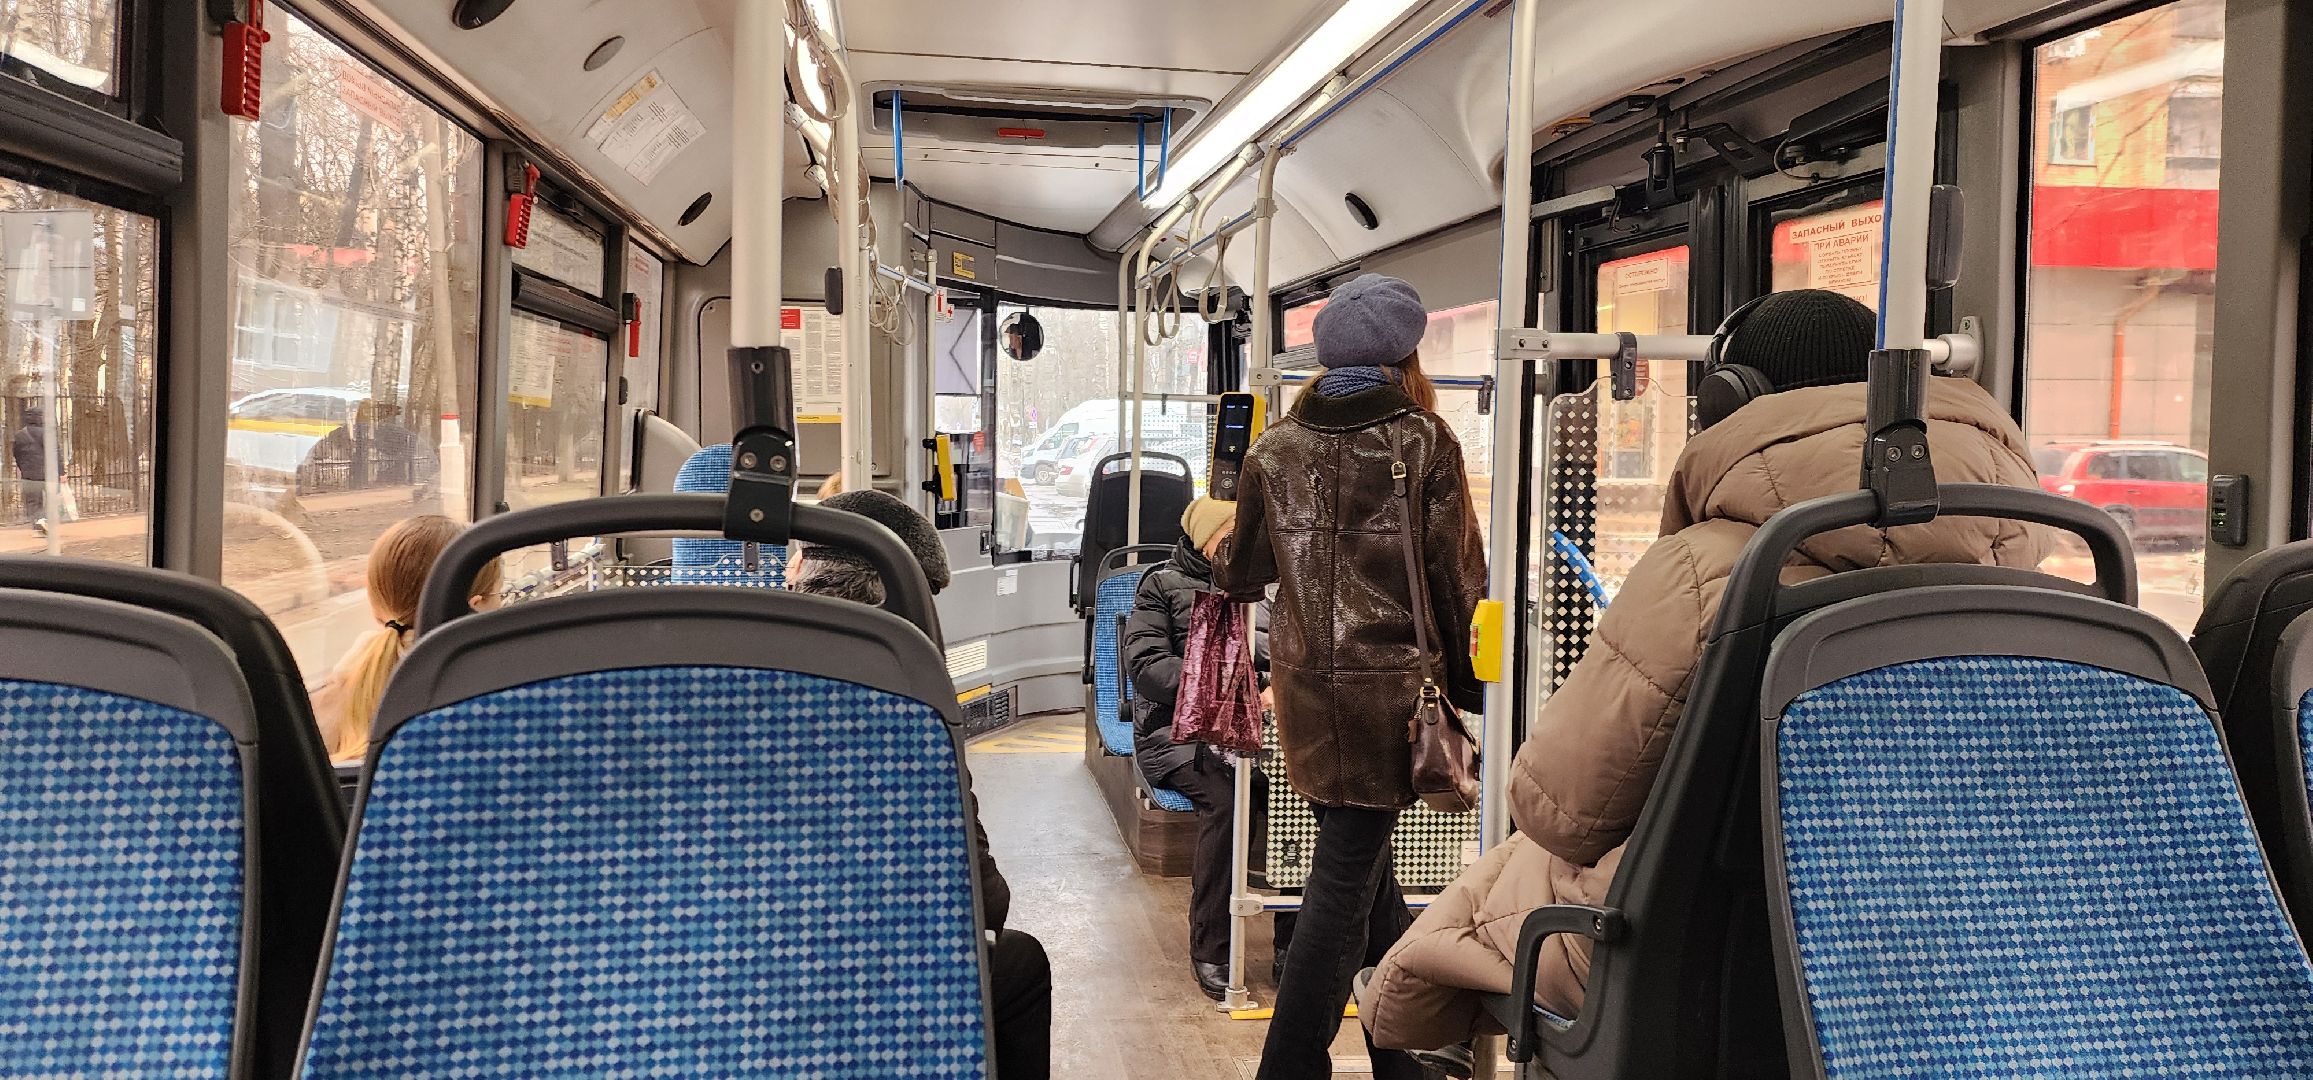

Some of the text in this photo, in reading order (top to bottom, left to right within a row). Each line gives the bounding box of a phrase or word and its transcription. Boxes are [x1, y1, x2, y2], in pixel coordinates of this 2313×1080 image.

[1792, 214, 1882, 238] ЗАПАСНЫЙ ВЫХО
[1814, 234, 1869, 251] ПРИ АВАРИИ
